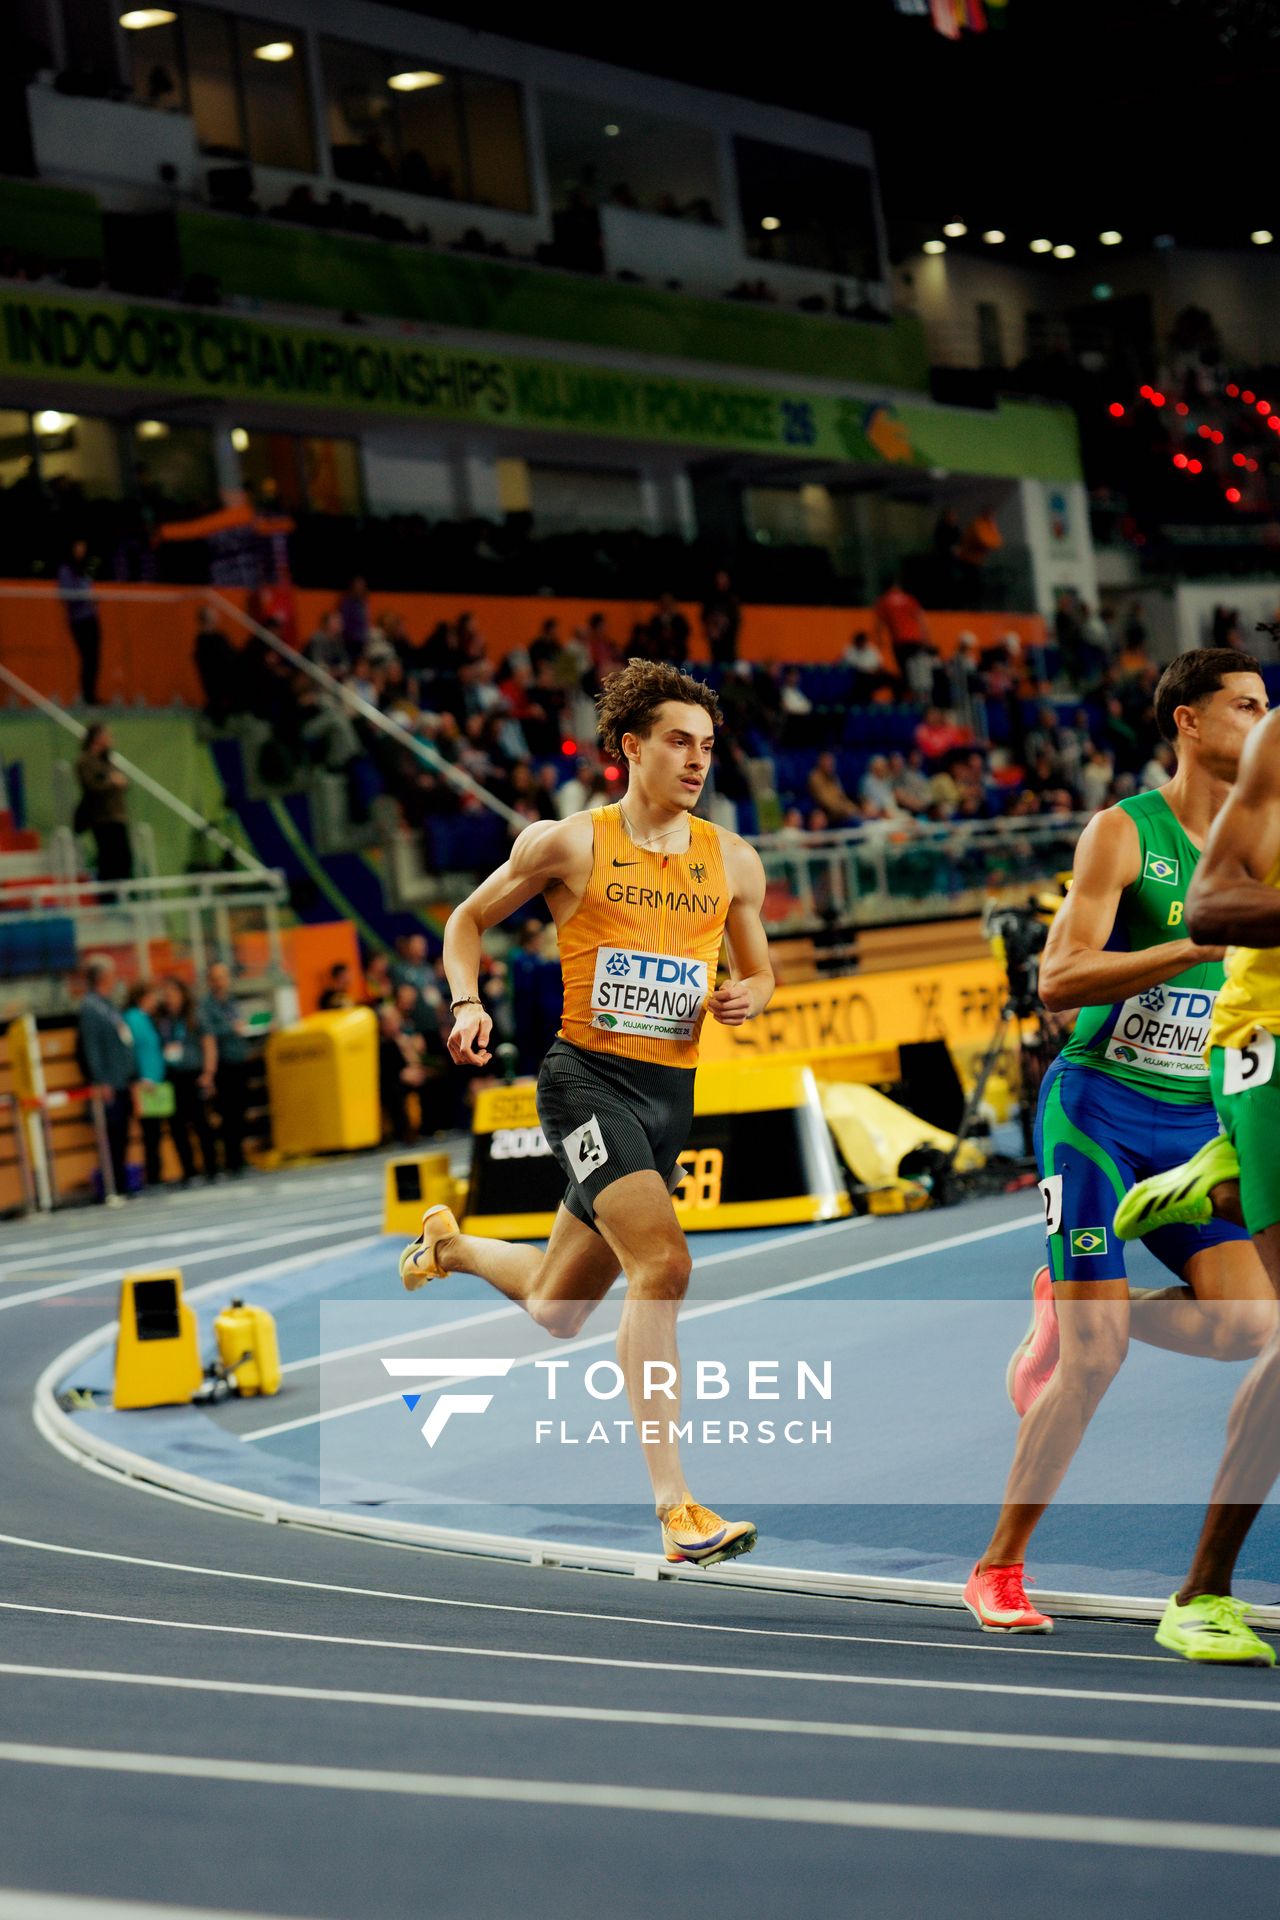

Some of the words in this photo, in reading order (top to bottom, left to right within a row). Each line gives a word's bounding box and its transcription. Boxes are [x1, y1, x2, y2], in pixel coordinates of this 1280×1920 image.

[6, 303, 187, 378] INDOOR
[194, 320, 509, 414] CHAMPIONSHIPS
[606, 882, 720, 915] GERMANY
[631, 954, 701, 989] TDK
[597, 981, 701, 1019] STEPANOV
[1168, 992, 1217, 1020] TD
[622, 1020, 654, 1032] KUJAWY
[654, 1024, 683, 1036] POMORZE
[728, 993, 876, 1054] SEIKO
[1143, 1056, 1175, 1068] KUJAWY
[1241, 1032, 1260, 1080] 5
[578, 1129, 601, 1163] 4
